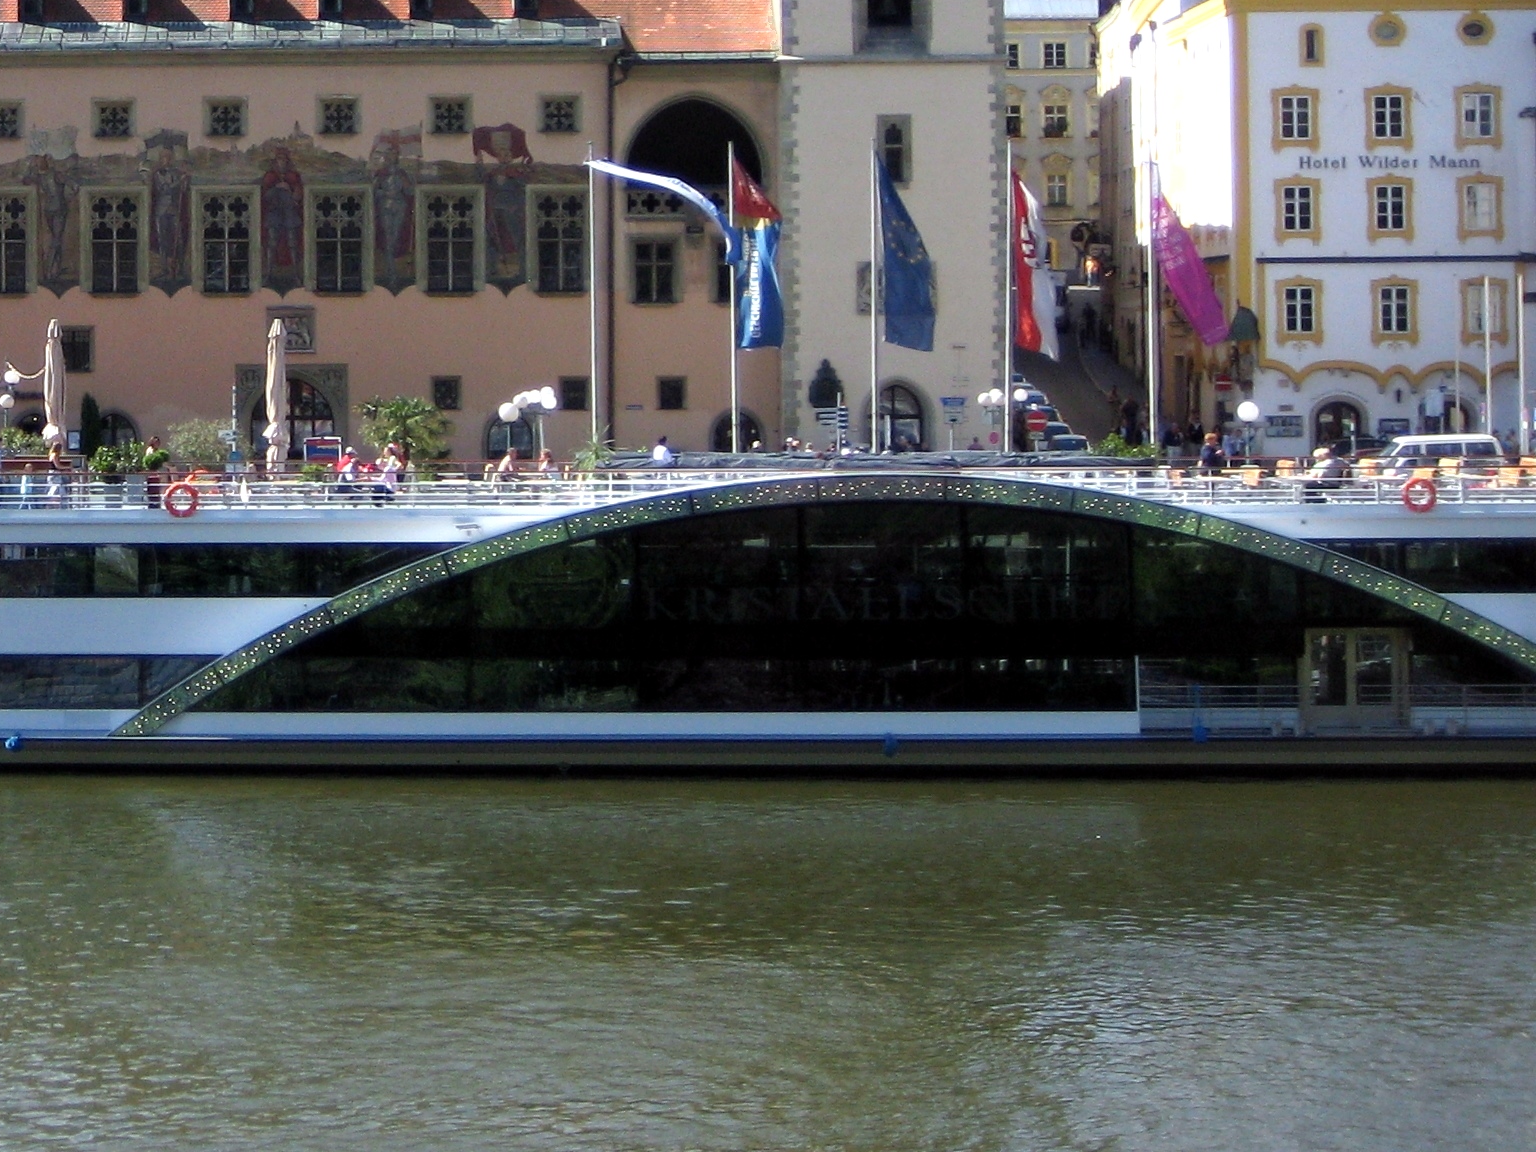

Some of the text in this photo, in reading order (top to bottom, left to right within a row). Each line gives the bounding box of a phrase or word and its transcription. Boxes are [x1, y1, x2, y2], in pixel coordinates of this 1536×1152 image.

[1299, 155, 1481, 170] Hotel Wilder Mann
